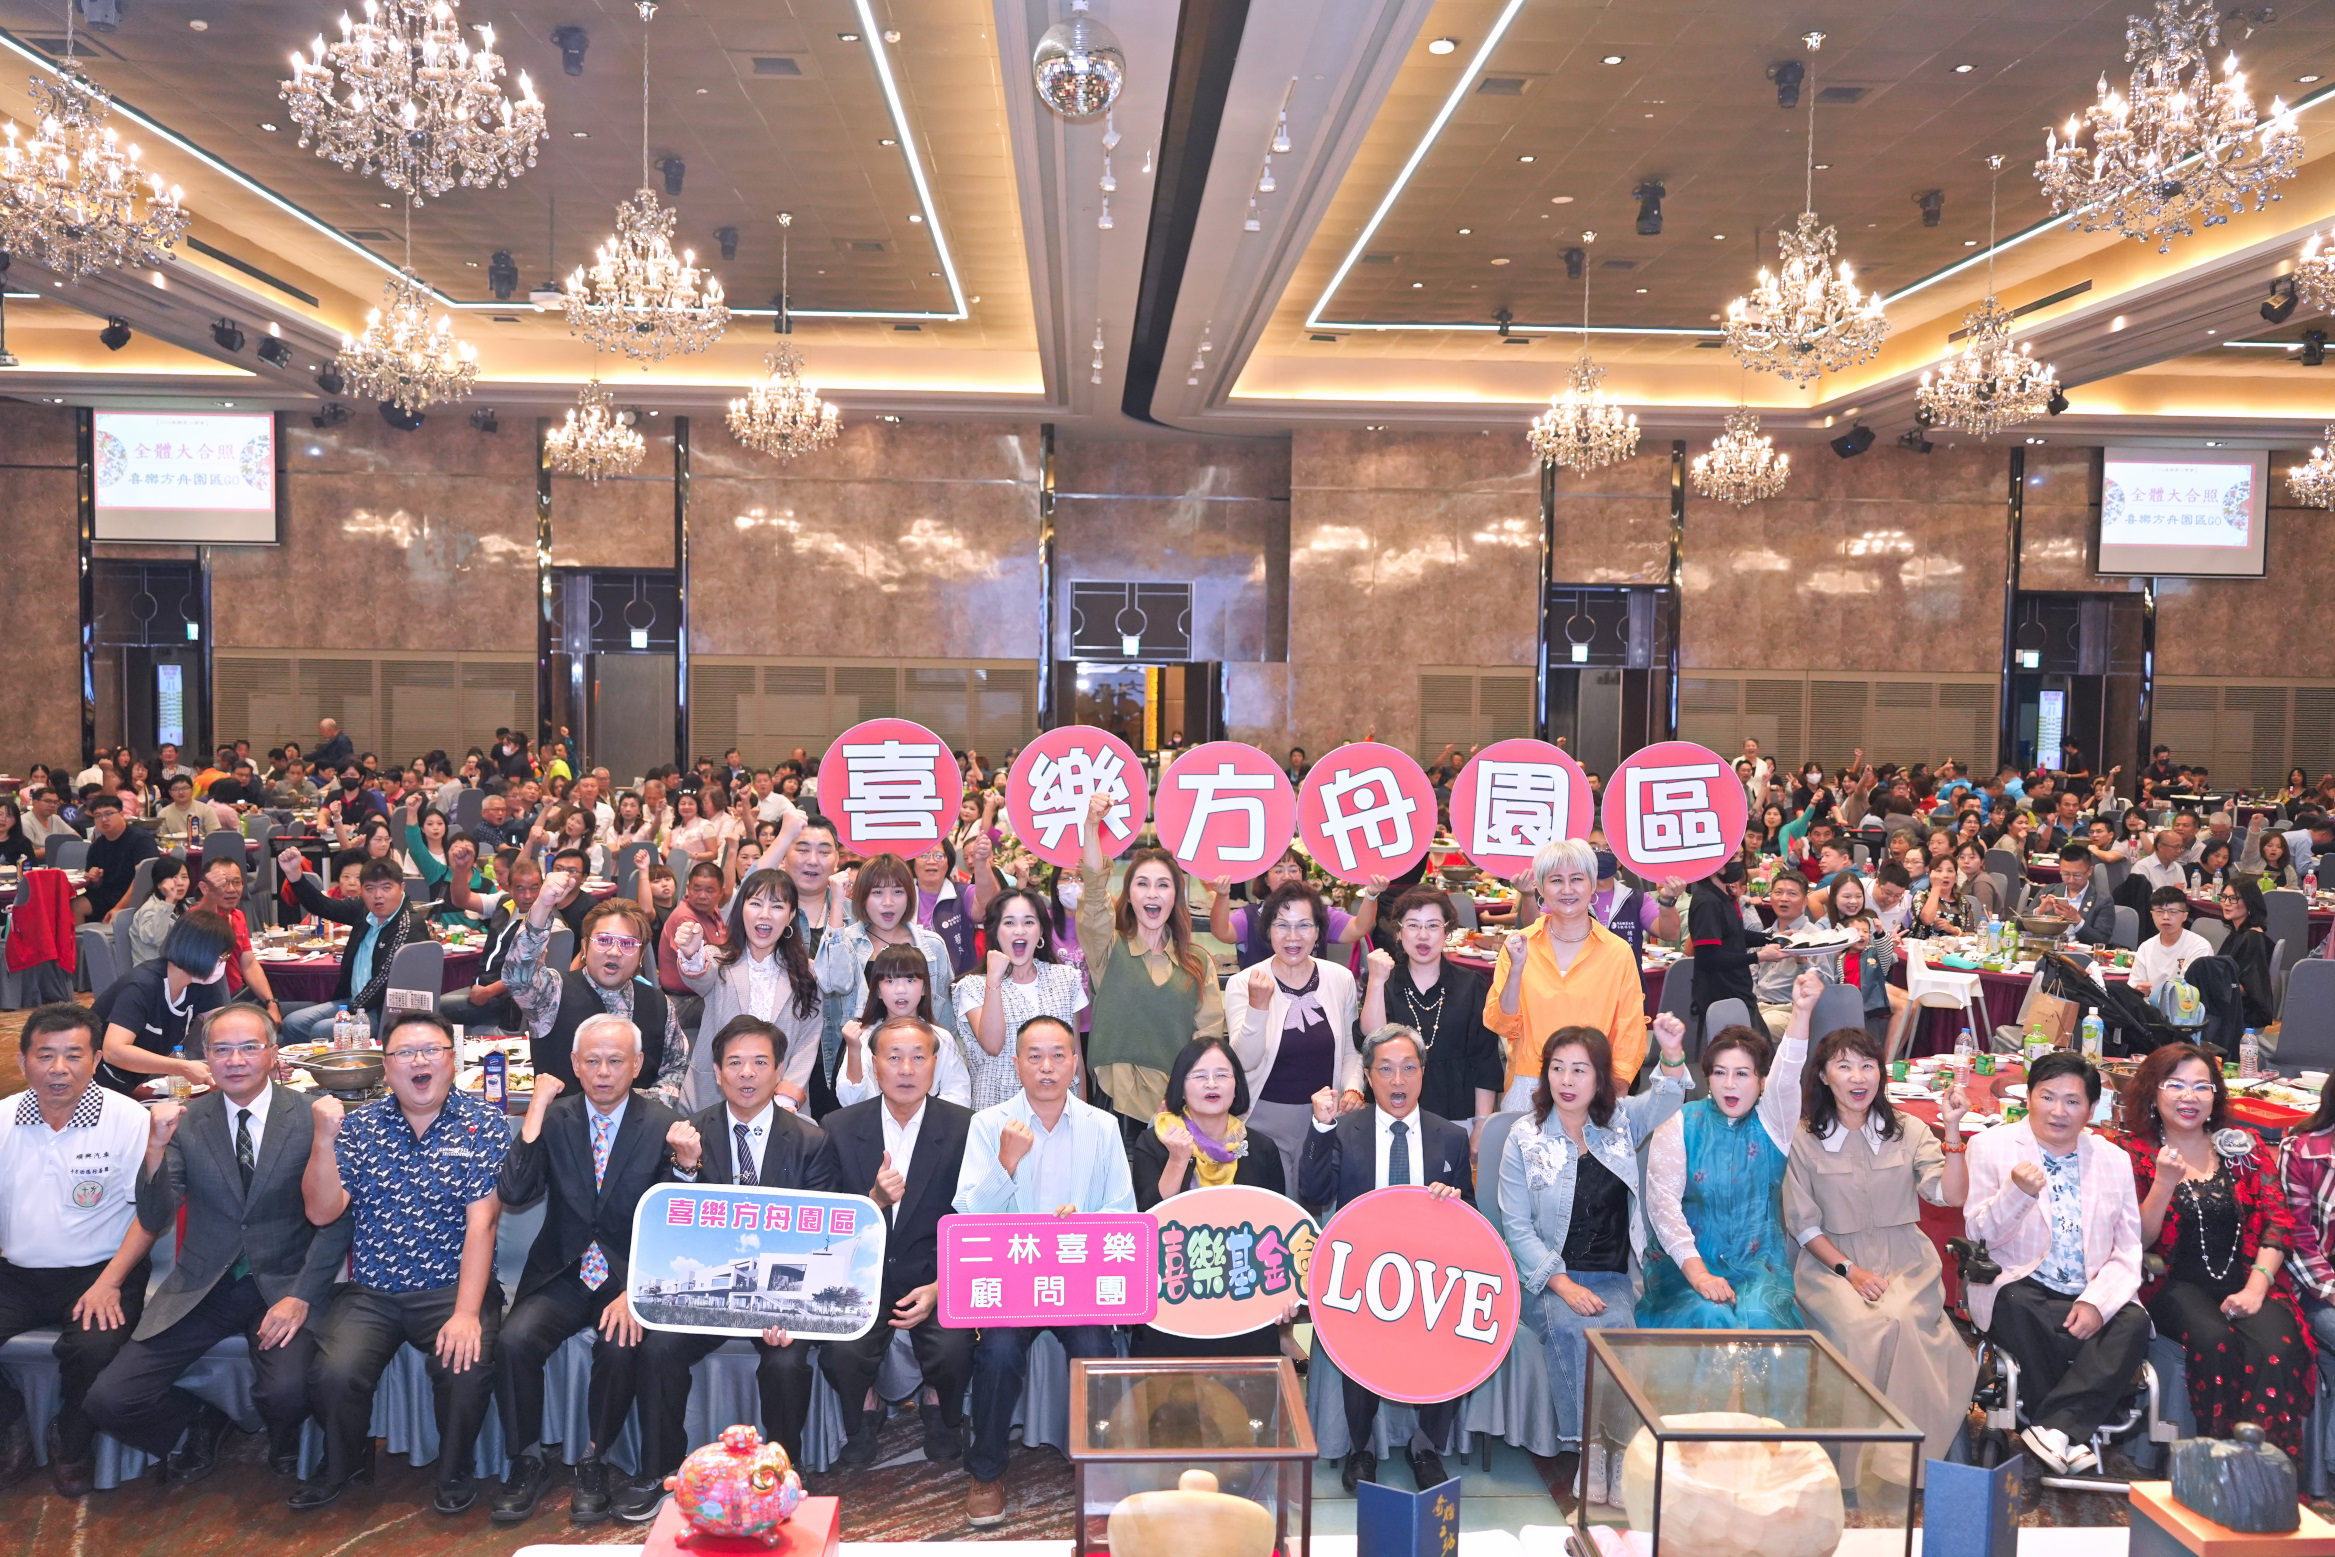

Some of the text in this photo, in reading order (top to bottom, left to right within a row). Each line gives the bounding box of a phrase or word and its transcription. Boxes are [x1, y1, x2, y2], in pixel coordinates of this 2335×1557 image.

[135, 442, 236, 460] 全體大合照
[2131, 488, 2219, 503] 全體大合照
[841, 739, 944, 842] 喜
[1027, 744, 1132, 850] 樂
[1176, 762, 1275, 862] 方
[1319, 766, 1417, 872] 舟
[1472, 759, 1570, 857] 園
[1625, 763, 1726, 864] 區
[667, 1198, 857, 1236] 喜樂方舟園區
[959, 1231, 1136, 1265] 二林喜樂
[969, 1275, 1127, 1309] 顧問團
[1321, 1239, 1503, 1345] LOVE
